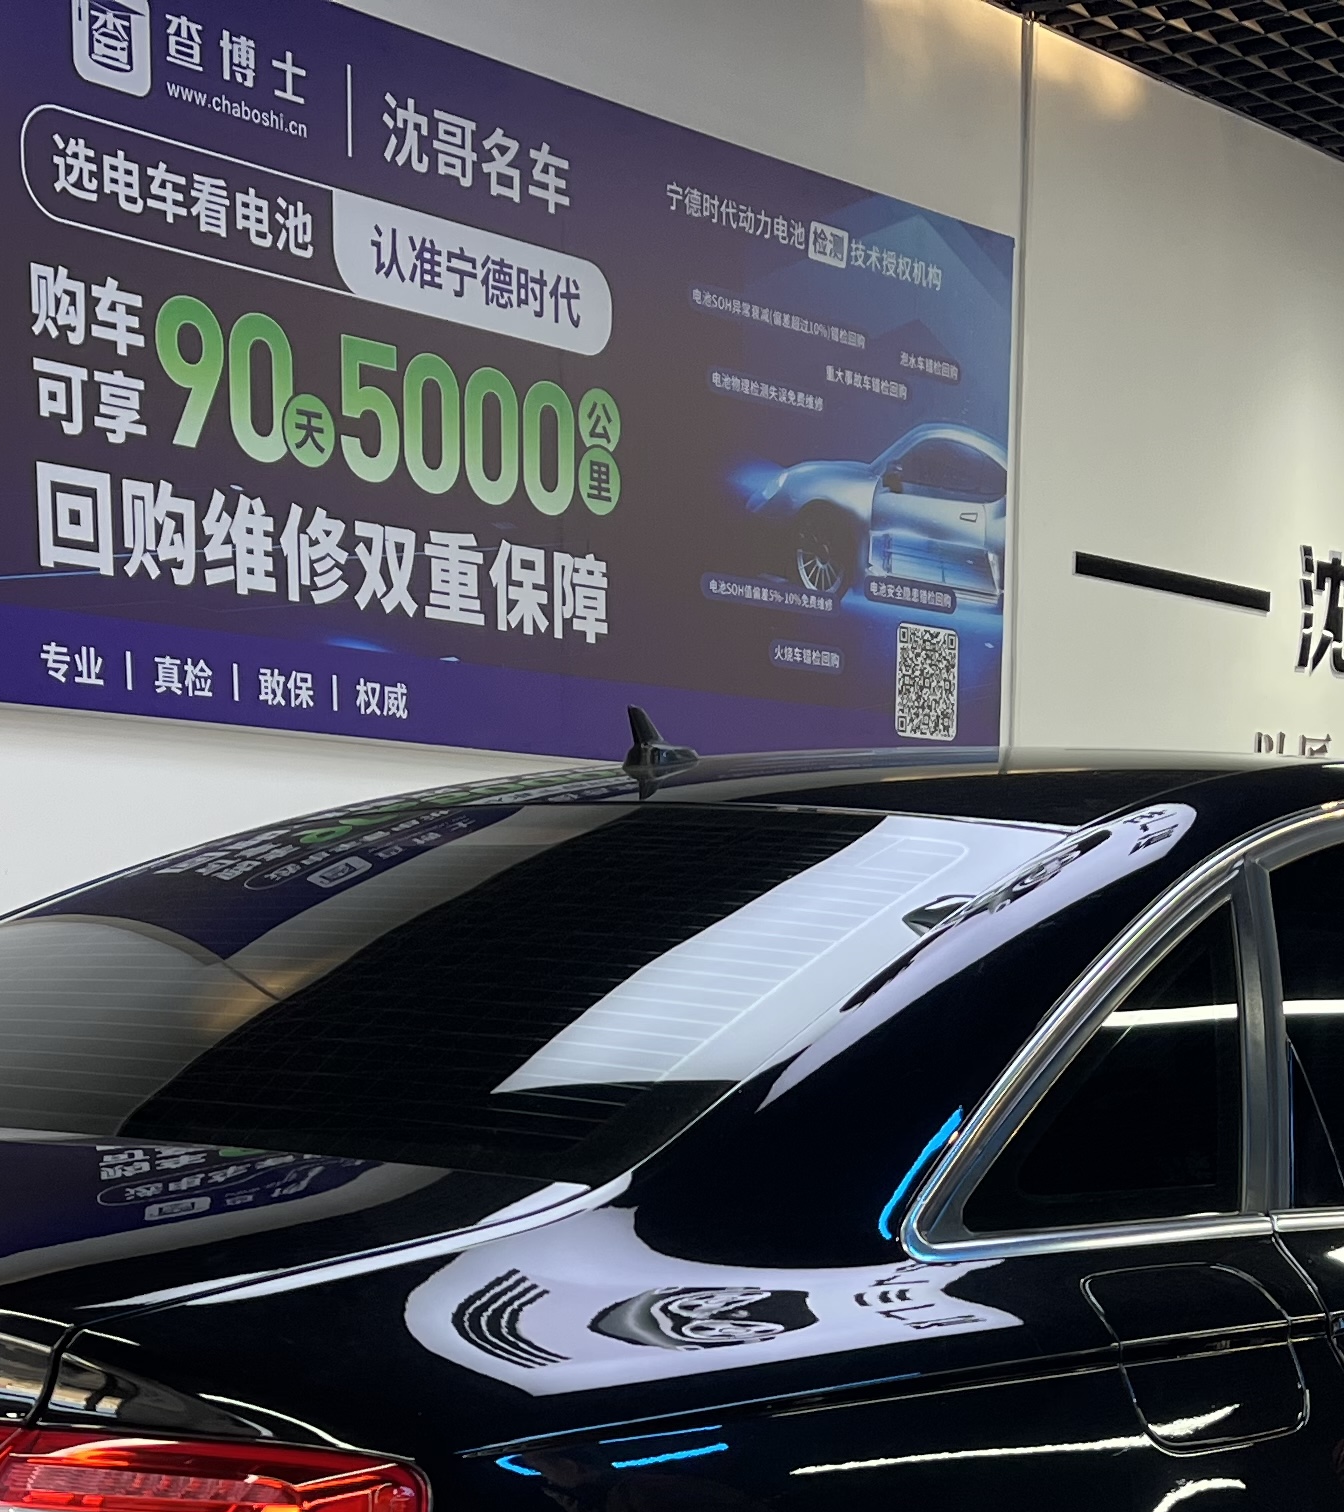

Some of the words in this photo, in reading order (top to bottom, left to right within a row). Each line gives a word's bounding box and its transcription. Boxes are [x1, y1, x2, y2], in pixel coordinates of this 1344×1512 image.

[165, 14, 307, 104] 查博士
[166, 81, 308, 138] www.chaboshi.cn
[382, 91, 571, 214] 沈哥名车
[52, 133, 314, 259] 选电车看电池
[30, 262, 146, 356] 购车
[371, 225, 582, 329] 认准宁德时代
[33, 358, 147, 445] 可享
[155, 295, 294, 463] 90
[293, 406, 326, 454] 天
[340, 334, 576, 516] 5000
[35, 461, 610, 644] 回购维修双重保障
[40, 641, 105, 687] 专业
[153, 655, 213, 699] 真检
[258, 667, 314, 709] 敢保
[355, 678, 409, 719] 权威
